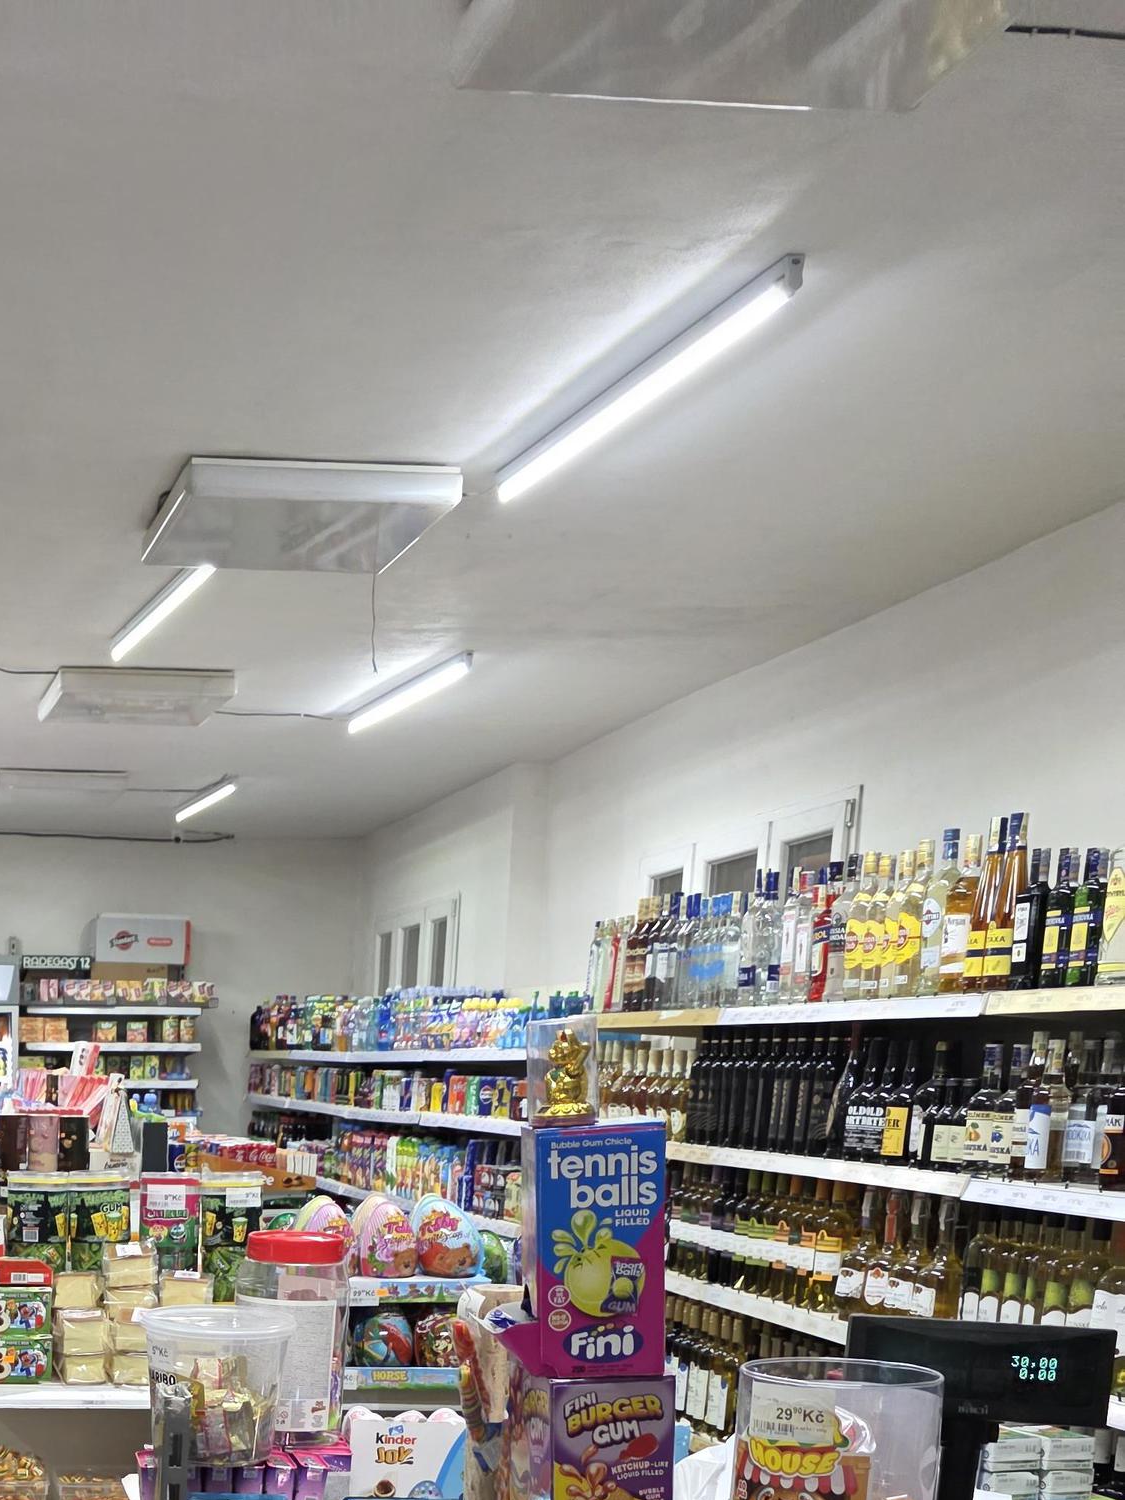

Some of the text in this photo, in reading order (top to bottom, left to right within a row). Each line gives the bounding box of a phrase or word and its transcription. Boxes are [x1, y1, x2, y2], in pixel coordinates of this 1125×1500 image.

[22, 956, 91, 969] RADEGAST 12
[551, 1138, 632, 1149] Bubble Gum Chicle
[548, 1145, 657, 1180] tennis
[570, 1176, 657, 1208] balls
[101, 1202, 122, 1213] GUM
[615, 1208, 650, 1217] LIQUID
[615, 1217, 650, 1227] FILLED
[608, 1301, 636, 1312] GUM
[570, 1325, 635, 1360] Fini
[1011, 1355, 1058, 1369] 30,00
[371, 1371, 408, 1381] HORSE
[1019, 1367, 1056, 1381] 0,00
[565, 1391, 598, 1418] FINI
[566, 1395, 663, 1437] BURGER
[593, 1420, 642, 1446] GUM
[375, 1446, 415, 1465] JOY
[750, 1439, 838, 1475] HOUSE
[641, 1469, 664, 1477] FILLED
[639, 1486, 665, 1496] BUBBLE
